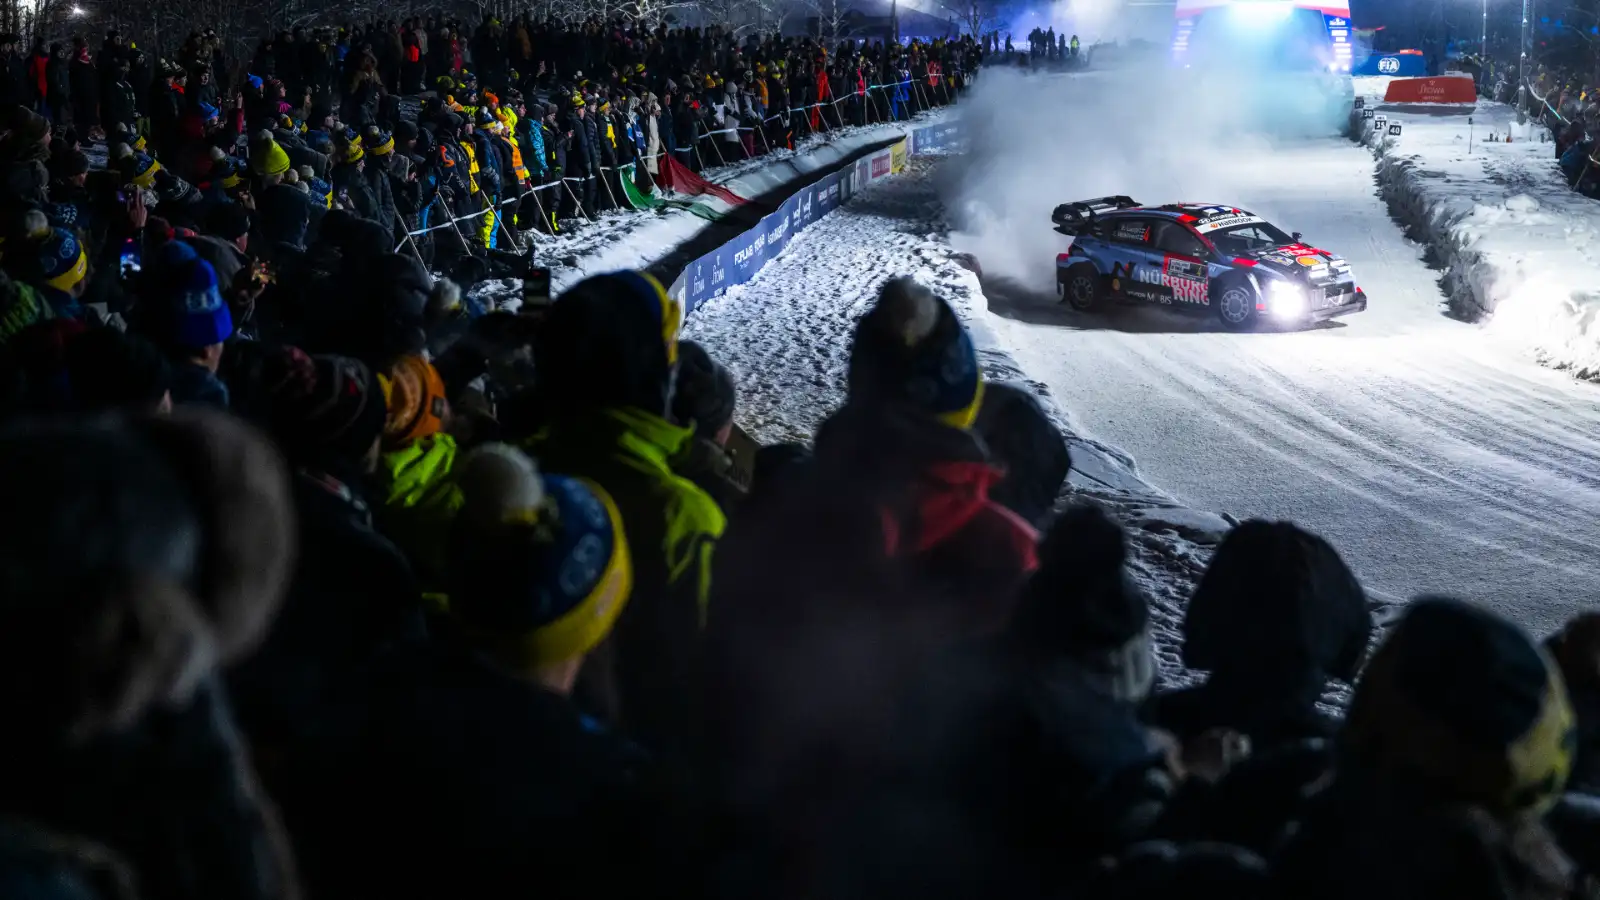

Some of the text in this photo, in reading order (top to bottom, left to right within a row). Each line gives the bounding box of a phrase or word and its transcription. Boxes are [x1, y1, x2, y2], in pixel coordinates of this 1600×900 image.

[1380, 60, 1398, 69] FIA
[1140, 269, 1209, 293] NÜRBURG
[1147, 292, 1172, 305] MBIS
[1173, 286, 1210, 306] RING
